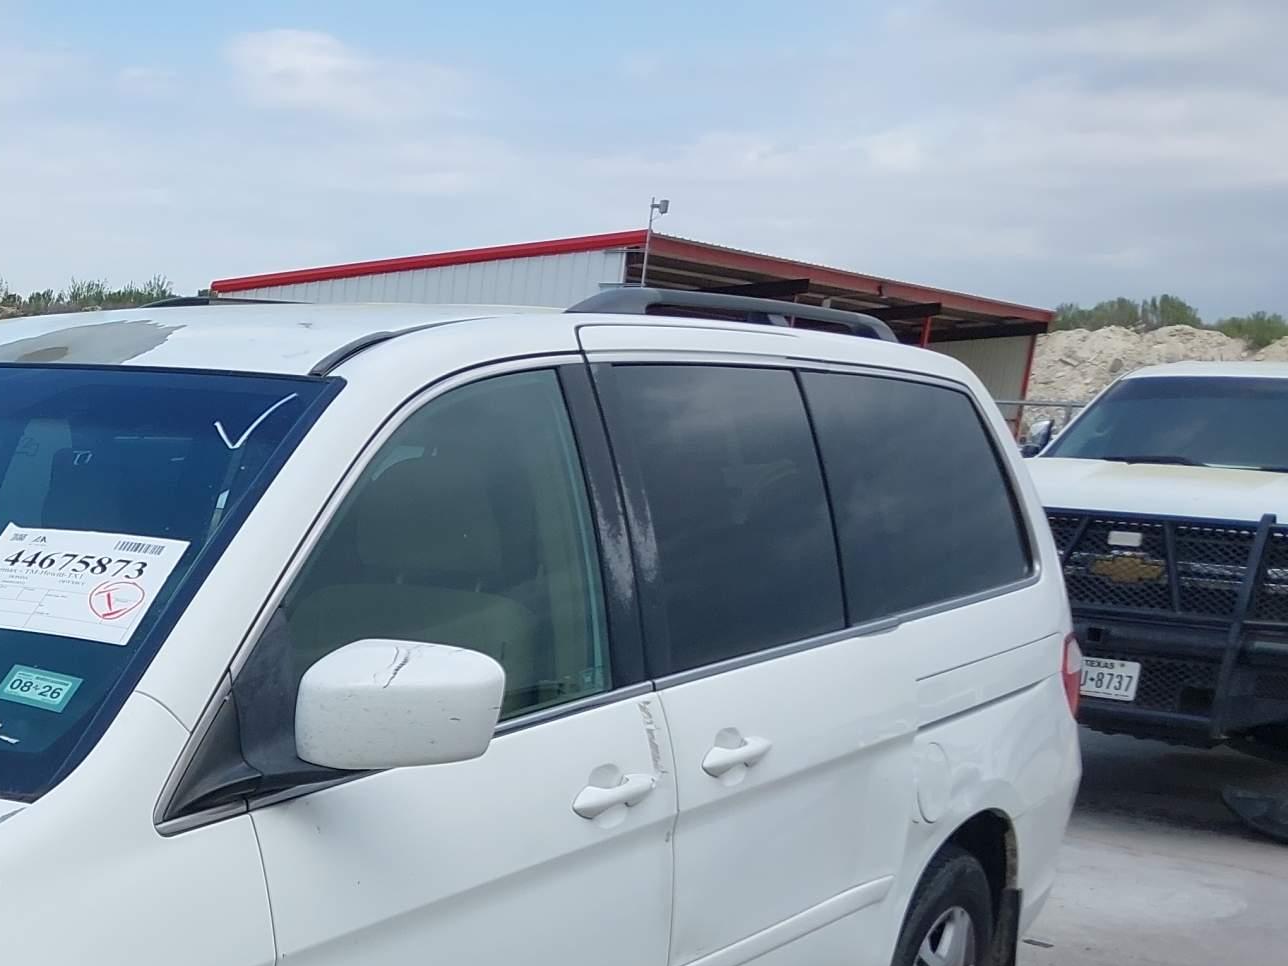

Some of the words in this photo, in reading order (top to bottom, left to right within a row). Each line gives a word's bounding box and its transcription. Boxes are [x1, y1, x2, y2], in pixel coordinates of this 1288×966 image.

[4, 549, 148, 580] 44675873
[1084, 660, 1115, 670] TEXAS
[9, 678, 33, 693] 08
[38, 684, 63, 699] 26
